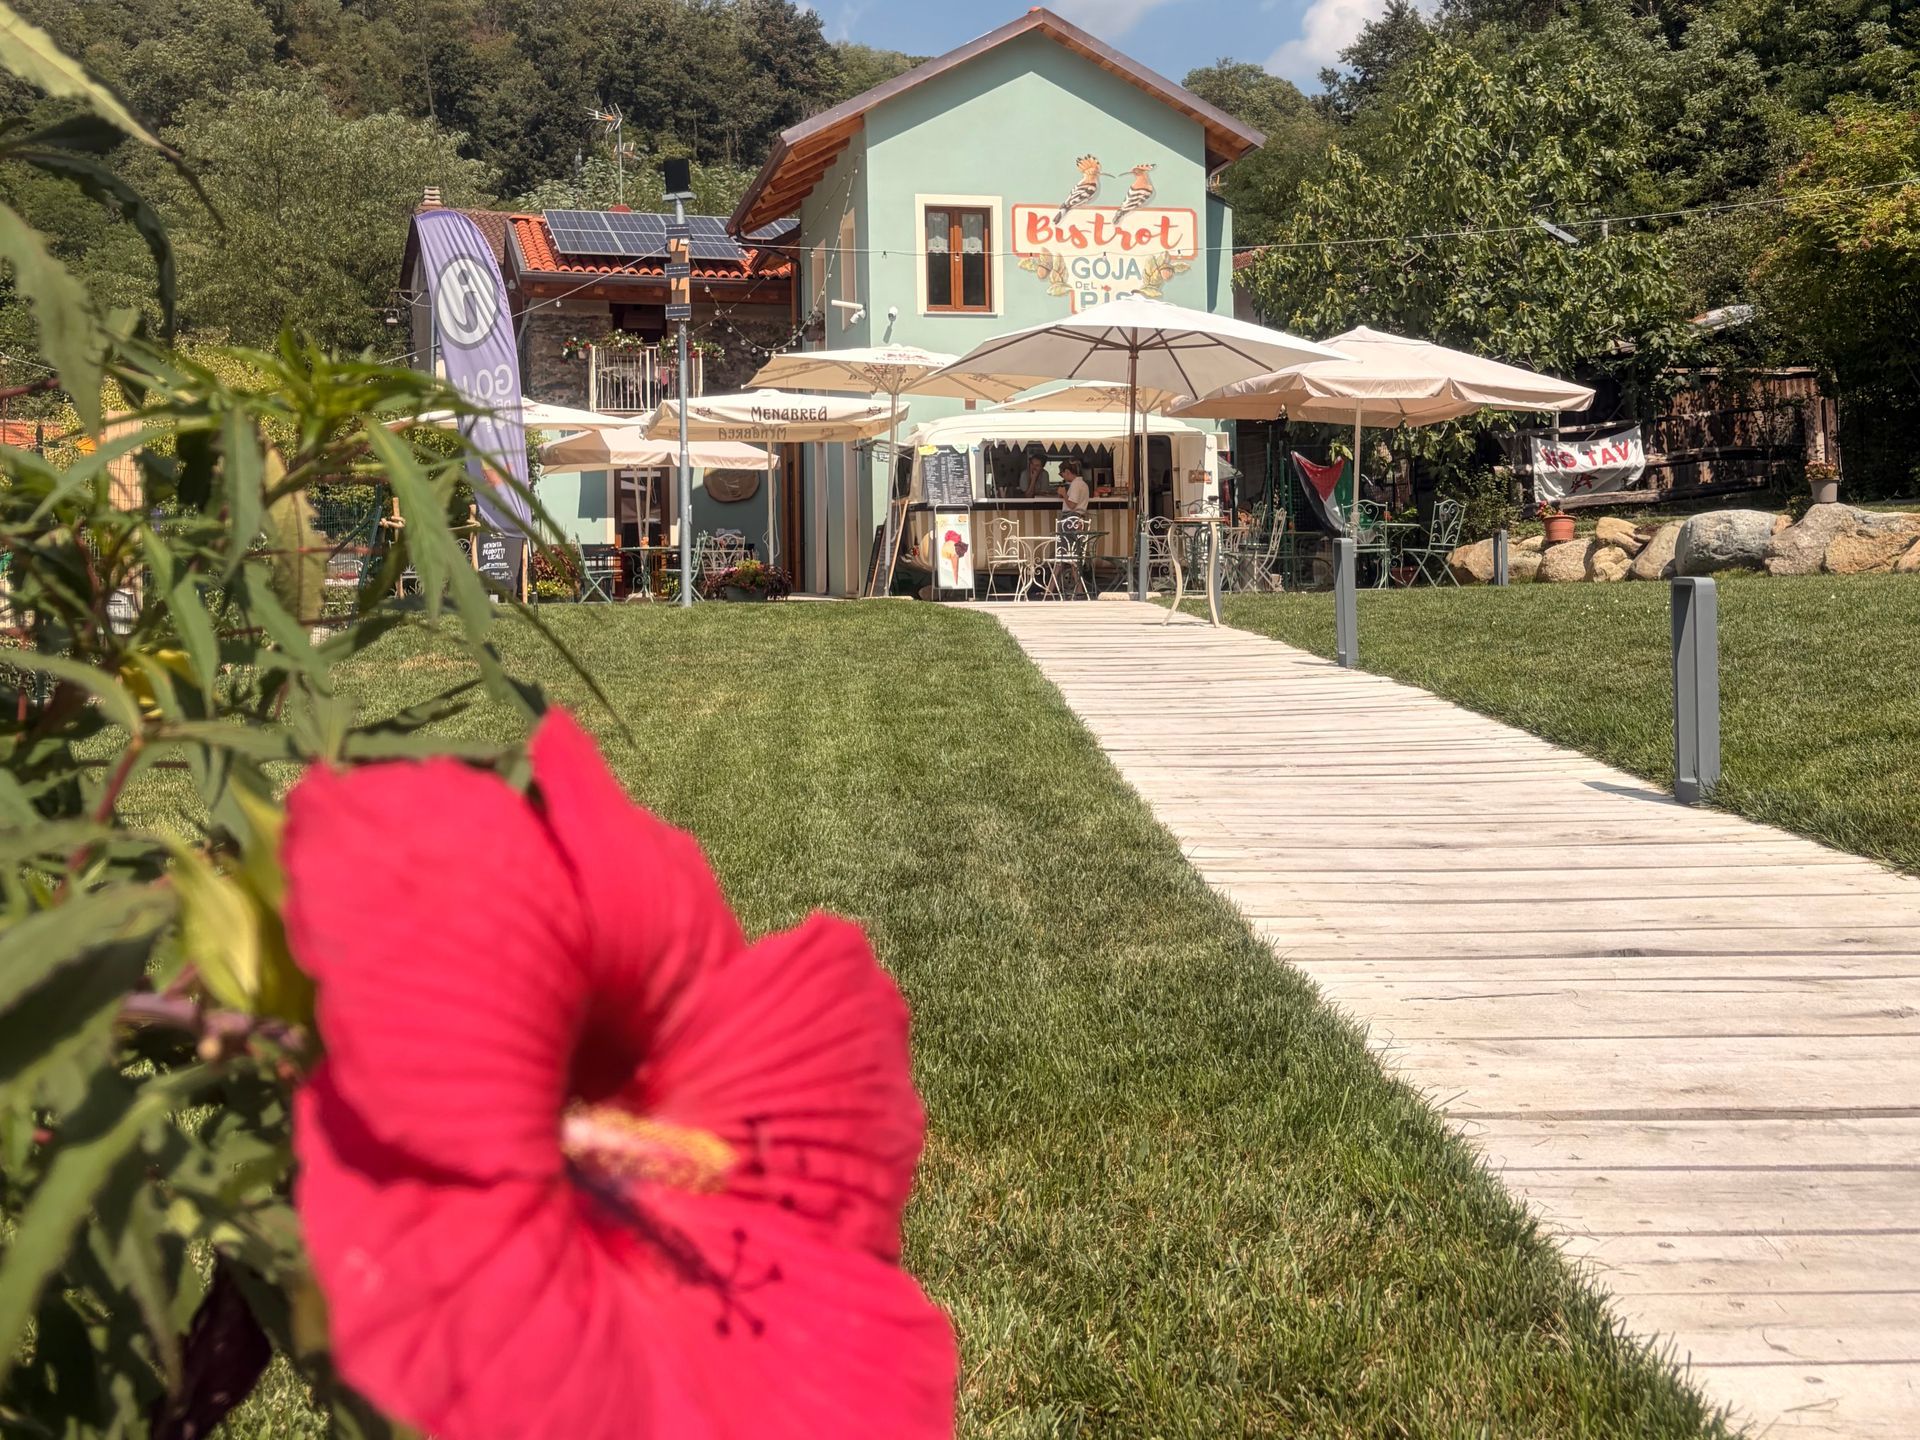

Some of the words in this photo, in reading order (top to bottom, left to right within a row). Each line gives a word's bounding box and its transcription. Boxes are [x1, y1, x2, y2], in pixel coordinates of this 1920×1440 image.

[1026, 211, 1184, 250] Bistrot
[1071, 257, 1143, 281] GOJA
[1075, 281, 1098, 291] DEL
[750, 406, 828, 422] MENABREA
[1541, 447, 1577, 469] NO
[1585, 438, 1630, 467] TAV
